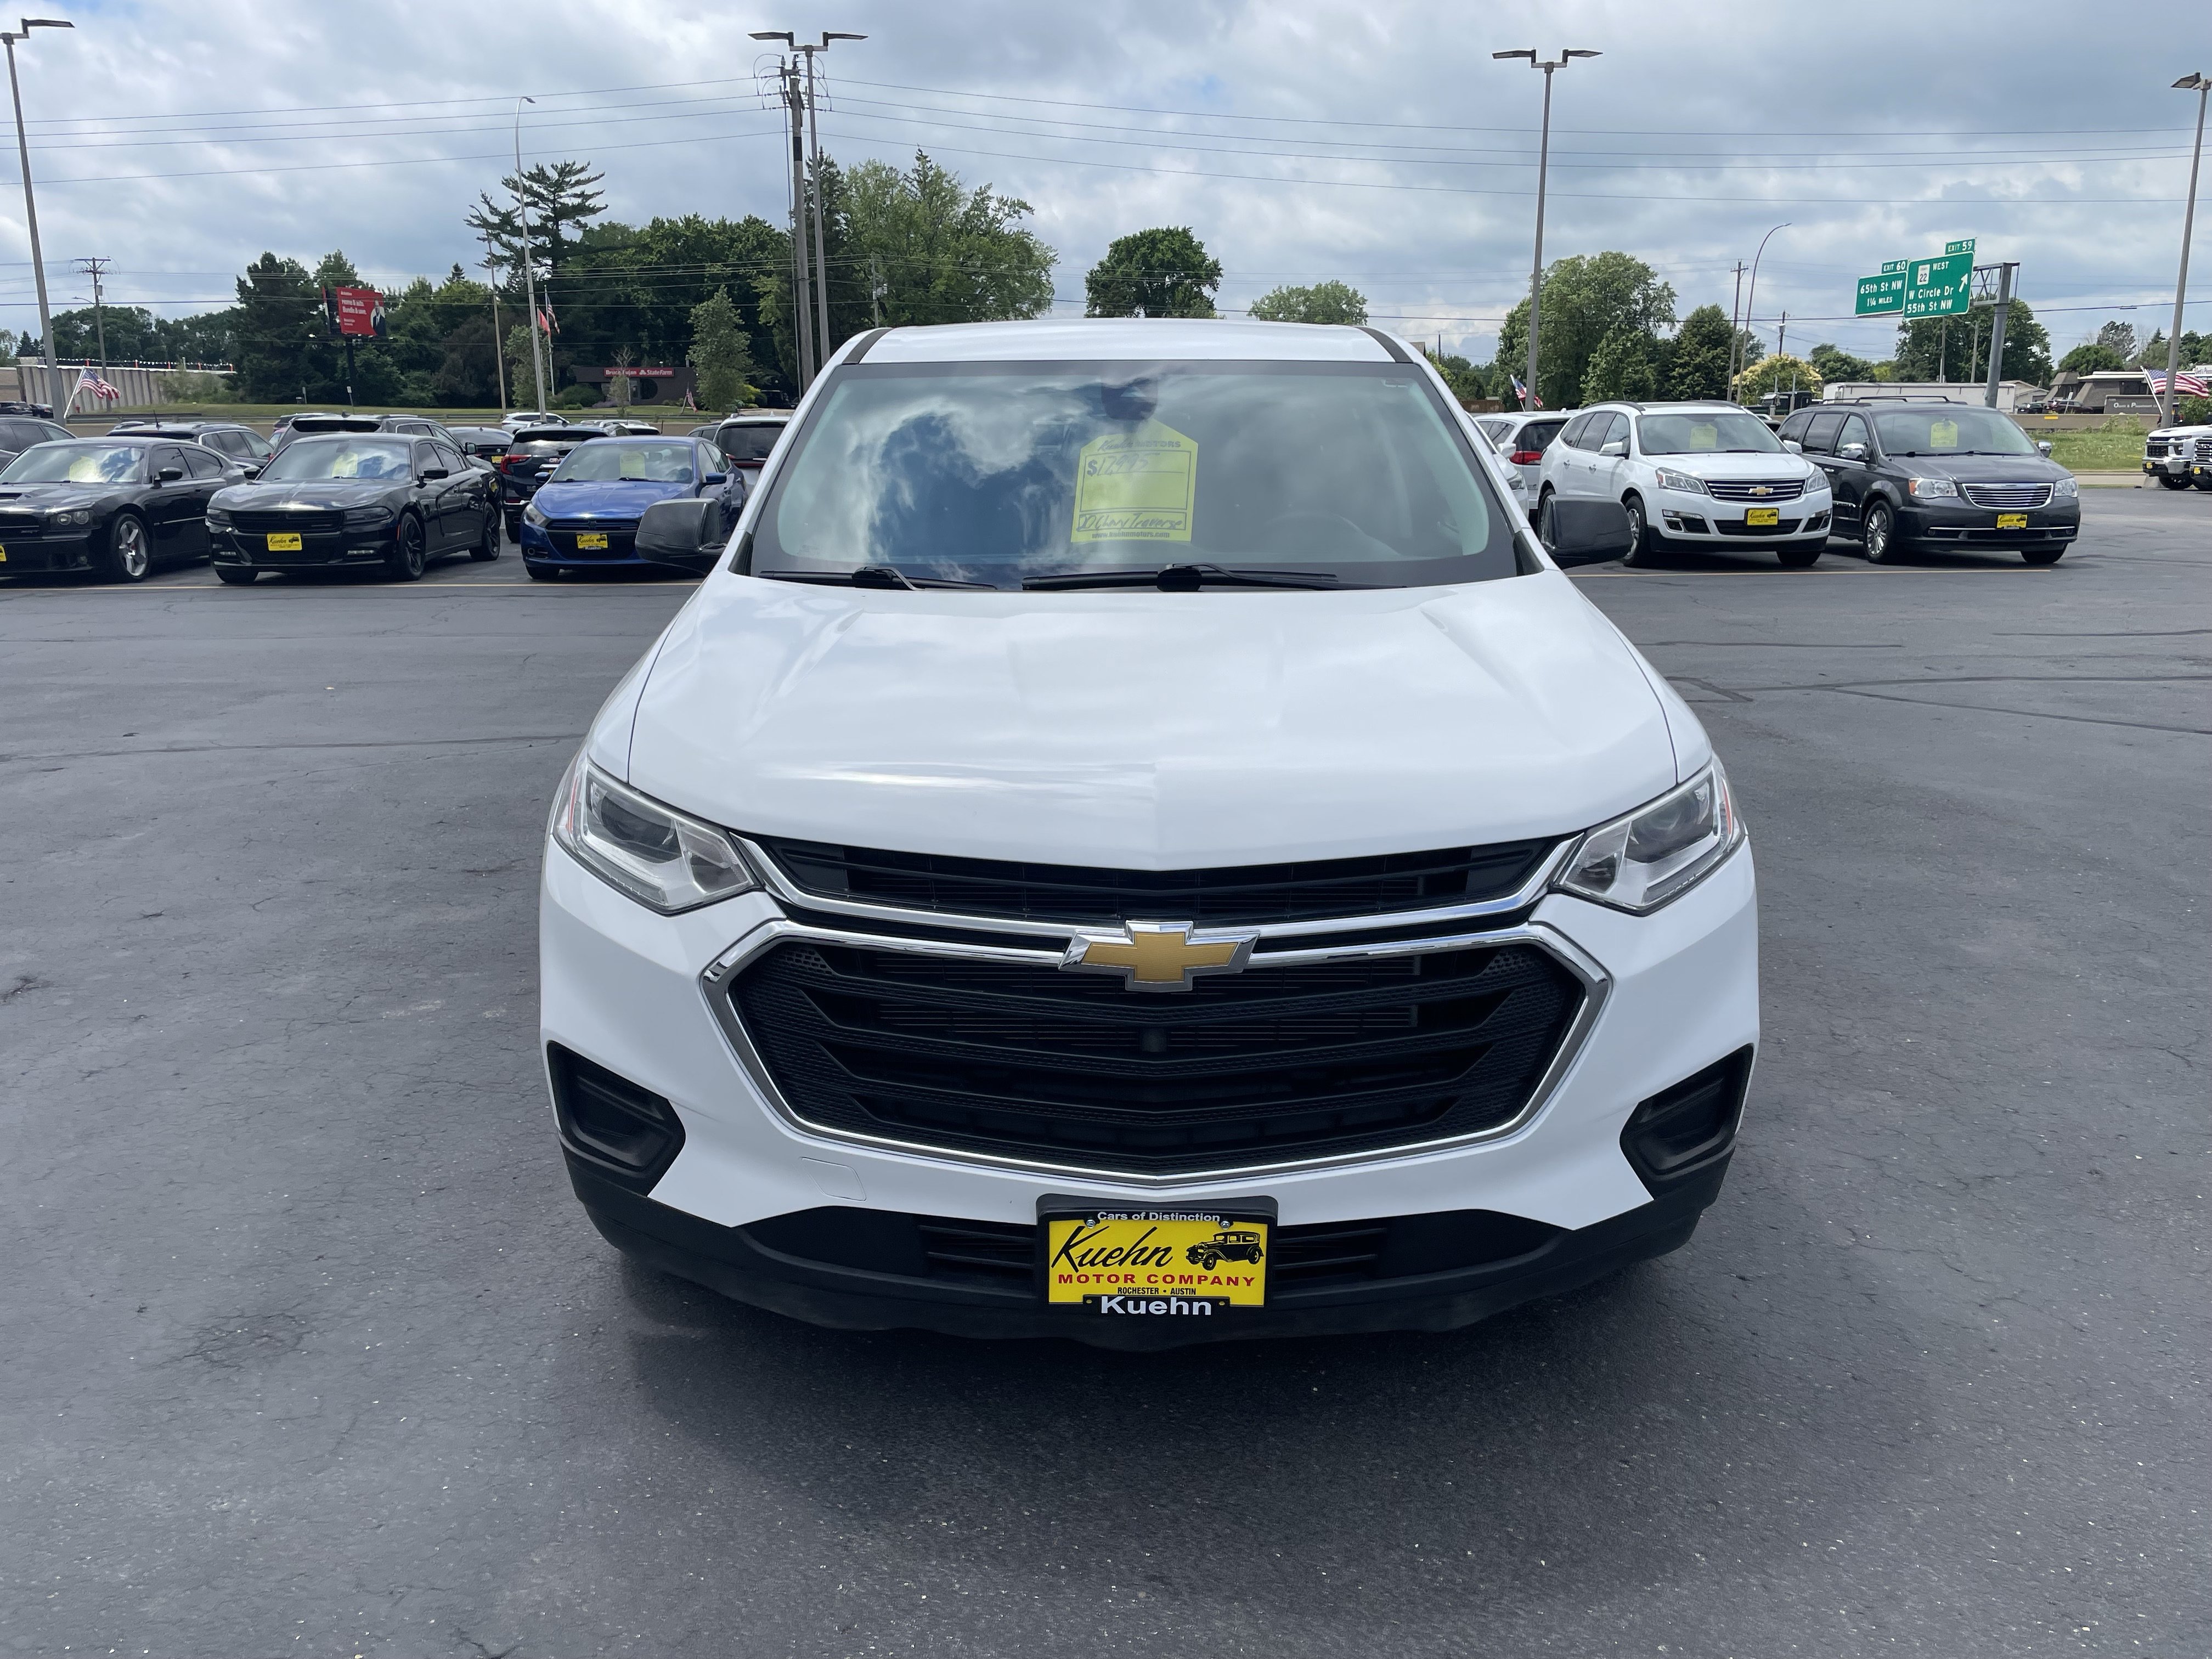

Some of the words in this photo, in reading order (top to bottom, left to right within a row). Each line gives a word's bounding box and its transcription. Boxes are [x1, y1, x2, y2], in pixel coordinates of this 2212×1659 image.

[1962, 241, 1972, 251] 59
[1897, 261, 1906, 270] 60
[1933, 261, 1949, 271] WEST
[1920, 273, 1927, 282] 22
[1860, 283, 1877, 294] 65th
[1880, 281, 1888, 291] St
[1891, 280, 1903, 290] NW
[1909, 290, 1915, 300] W
[1918, 288, 1940, 299] Circle
[1944, 286, 1954, 296] Dr
[1878, 296, 1893, 304] MILES
[1907, 303, 1925, 314] 55th
[1928, 301, 1937, 311] St
[1940, 299, 1953, 309] NW
[1097, 1211, 1128, 1221] Cars
[1132, 1211, 1146, 1221] of
[1149, 1212, 1220, 1222] Distinction
[1051, 1226, 1173, 1273] Kuehn
[1058, 1274, 1136, 1284] MOTOR
[1147, 1274, 1256, 1286] COMPANY
[1118, 1286, 1159, 1295] ROCHESTER
[1170, 1287, 1197, 1295] AUSTIN
[1101, 1296, 1211, 1315] Kuehn
